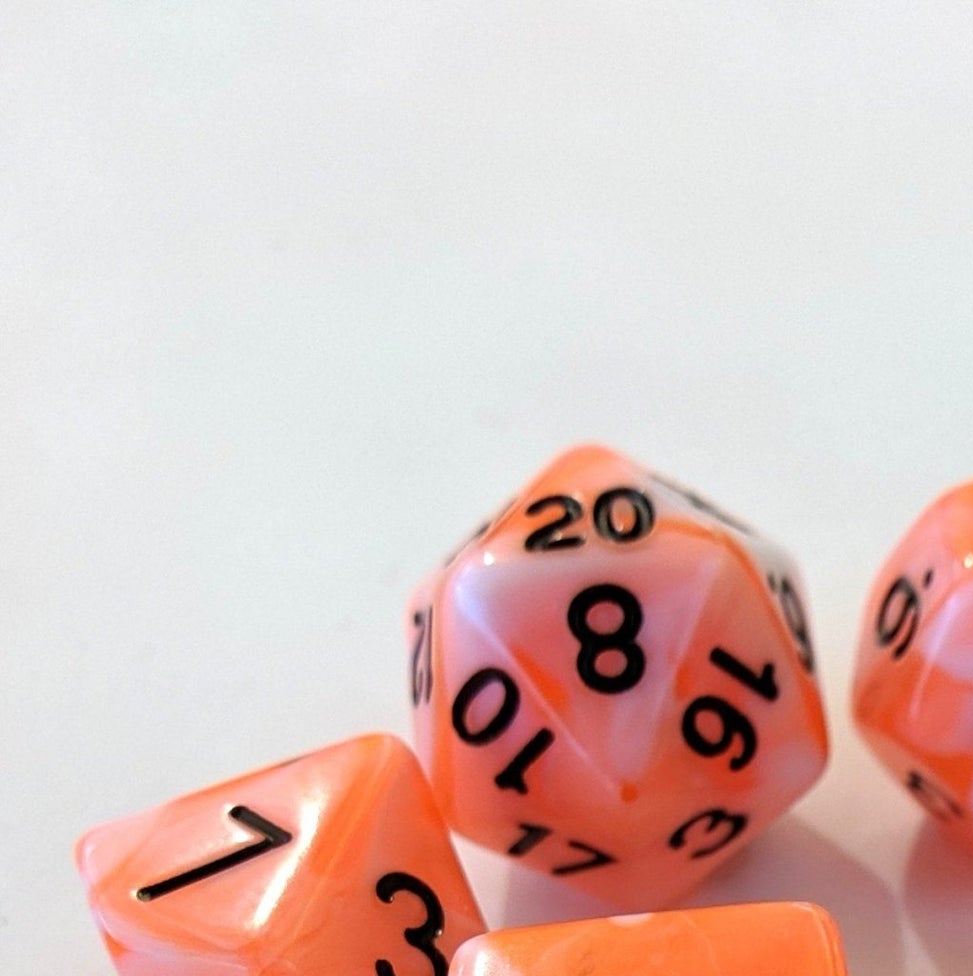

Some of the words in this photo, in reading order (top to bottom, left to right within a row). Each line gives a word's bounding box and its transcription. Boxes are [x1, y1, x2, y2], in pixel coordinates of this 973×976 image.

[525, 486, 655, 553] 20
[567, 583, 646, 695] 8
[451, 667, 554, 795] 10
[681, 647, 780, 771] 16
[508, 822, 617, 876] 17
[668, 808, 748, 860] 3
